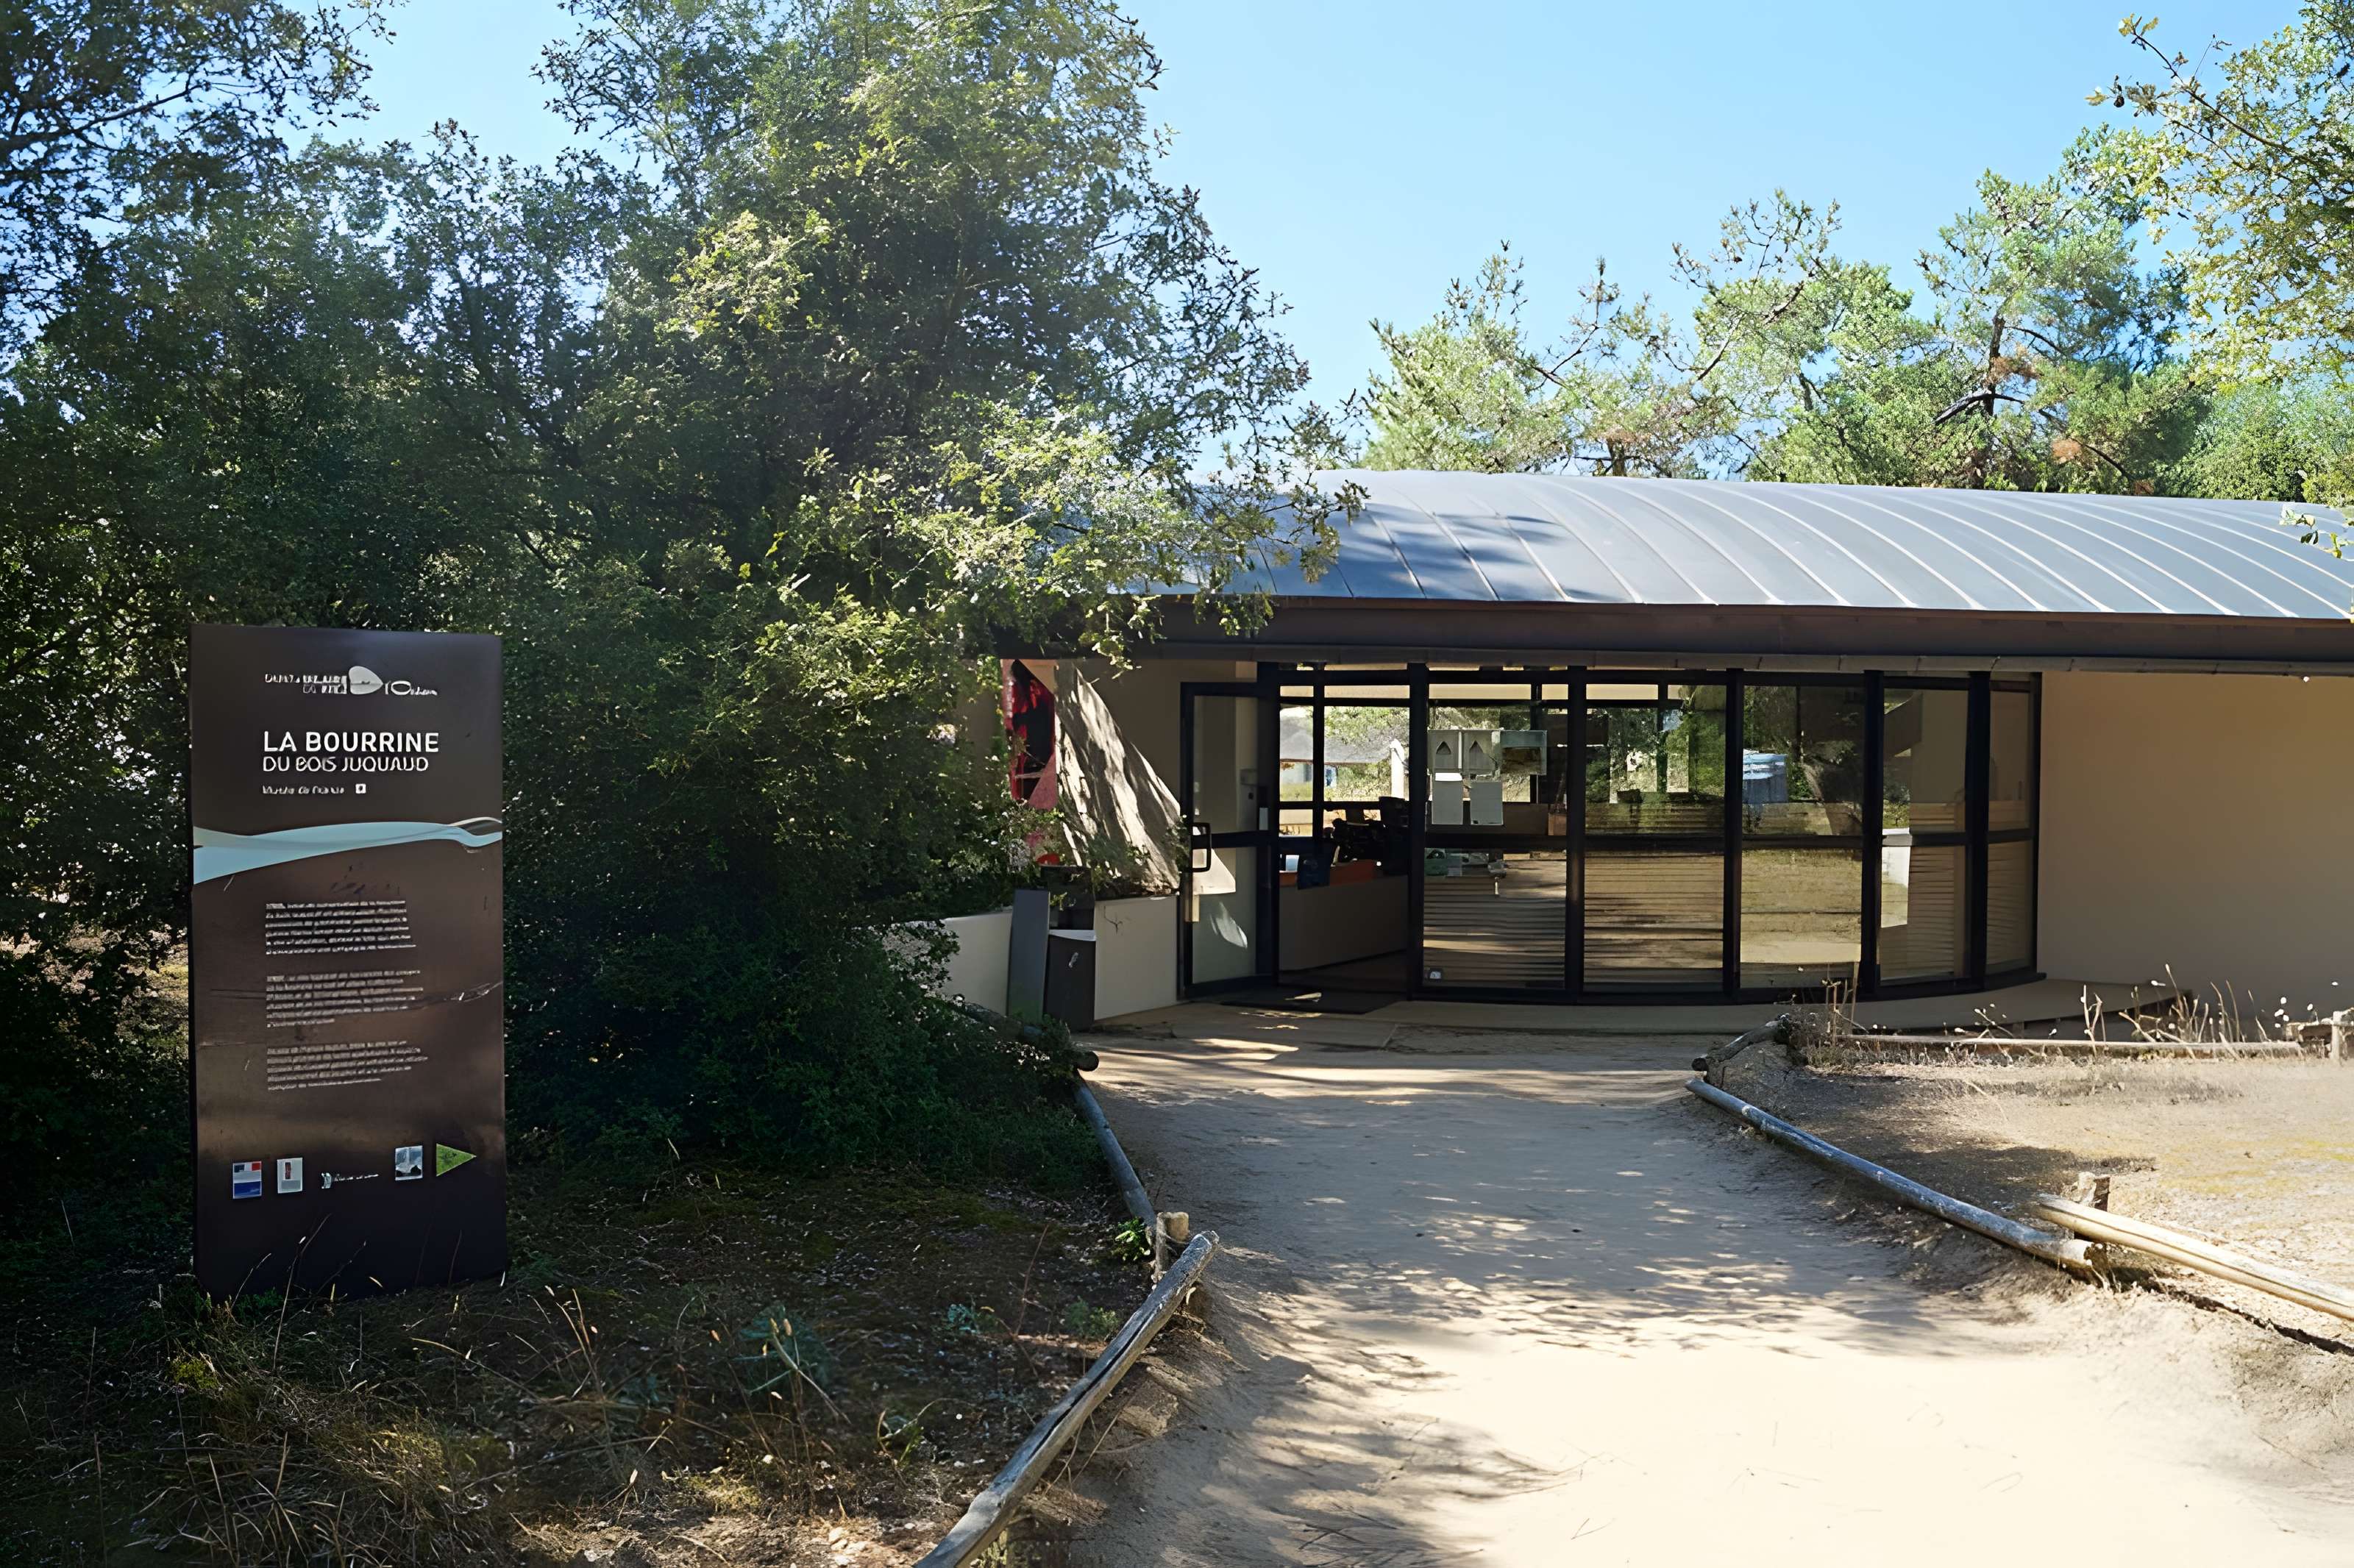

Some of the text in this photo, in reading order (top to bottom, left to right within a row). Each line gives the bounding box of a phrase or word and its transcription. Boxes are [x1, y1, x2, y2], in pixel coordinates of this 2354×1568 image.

[263, 731, 439, 753] LA BOURRINE
[263, 756, 290, 771] DU
[341, 756, 429, 772] JUQUAUD
